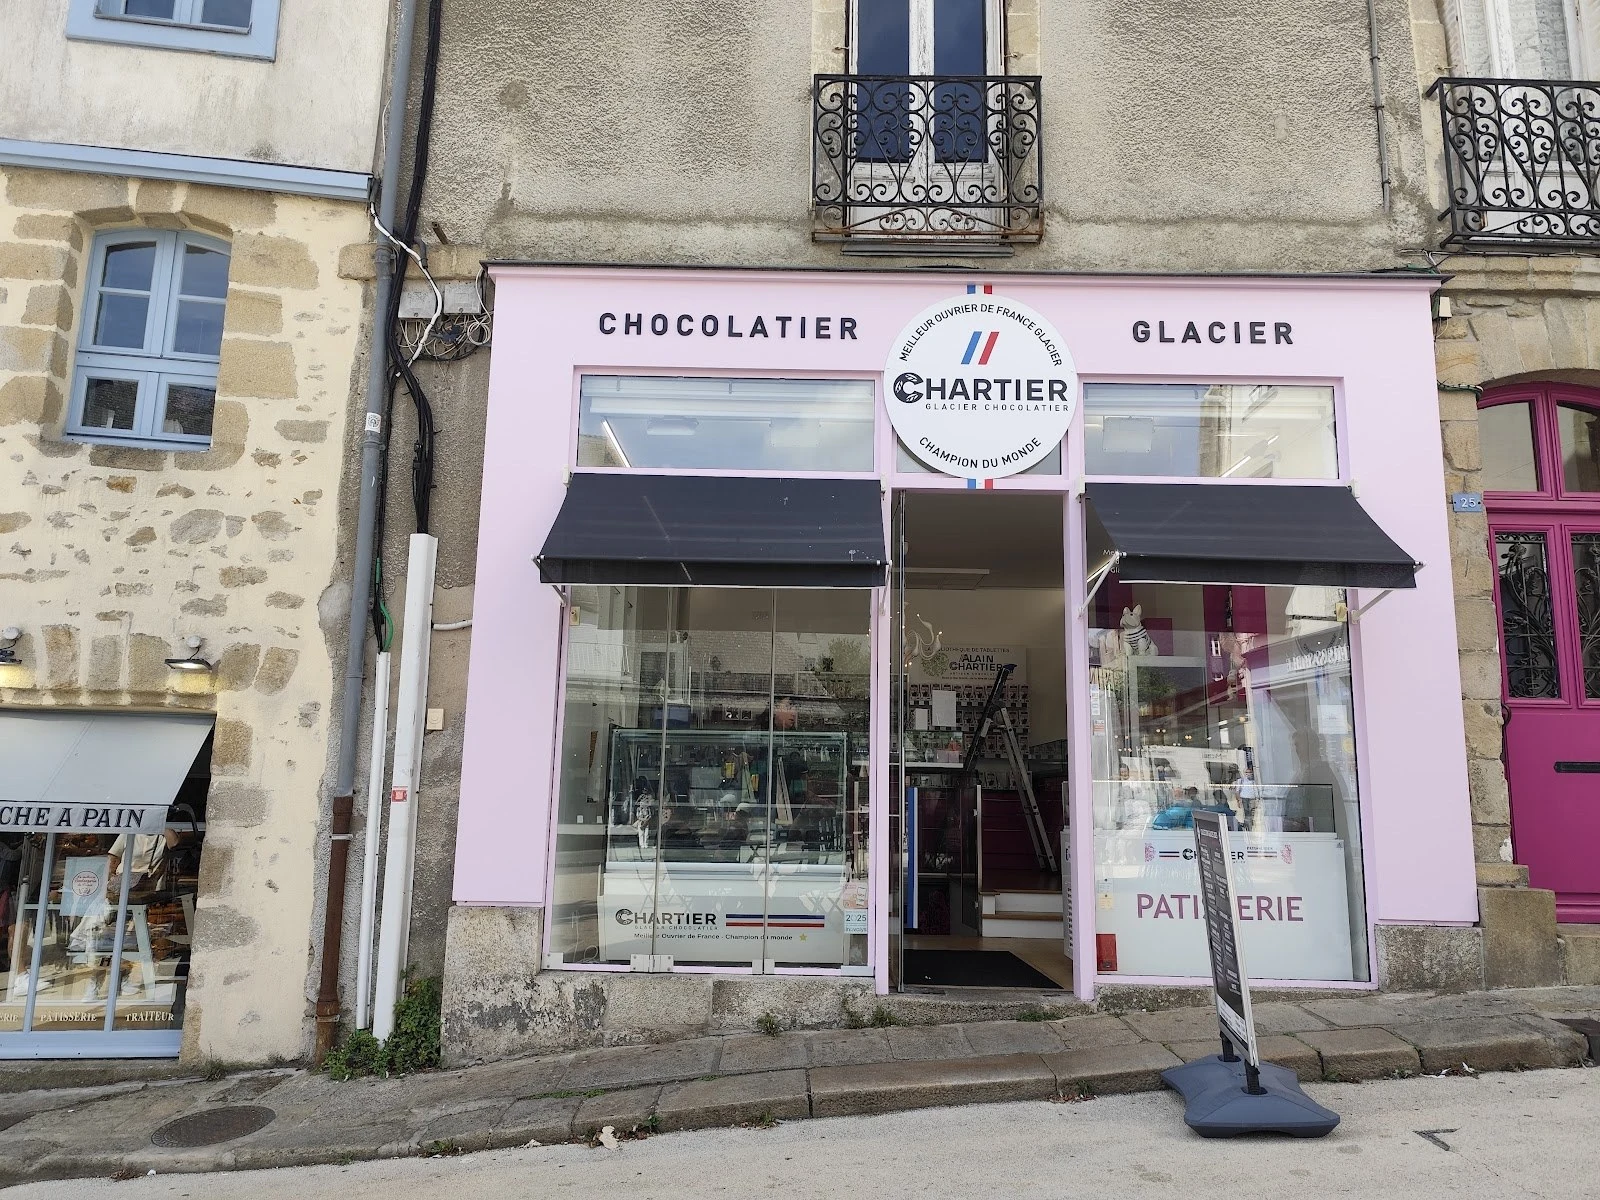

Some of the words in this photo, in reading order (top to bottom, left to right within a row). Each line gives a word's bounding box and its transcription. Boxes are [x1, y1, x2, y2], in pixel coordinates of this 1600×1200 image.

[599, 312, 858, 340] CHOCOLATIER
[899, 319, 935, 362] MEILLEUR
[934, 303, 978, 323] OUVRIER
[980, 303, 994, 314] DE
[996, 305, 1037, 331] FRANCE
[1033, 328, 1063, 367] GLACIER
[1132, 321, 1294, 345] GLACIER
[892, 372, 1068, 404] CHARTIER
[925, 403, 978, 411] GLACIER
[984, 404, 1069, 412] CHOCOLATIER
[919, 436, 979, 469] CHAMPION
[982, 458, 998, 469] DU
[1001, 437, 1042, 466] MONDE
[1460, 497, 1476, 508] 25
[959, 653, 994, 663] ALAIN
[81, 808, 146, 828] PAIN
[615, 908, 717, 926] CHARTIER
[1136, 893, 1304, 922] PATIERIE
[845, 914, 867, 922] 2025
[725, 933, 759, 941] Champion
[40, 1012, 98, 1022] PATISSERIE
[125, 1011, 174, 1022] TRAITEUR
